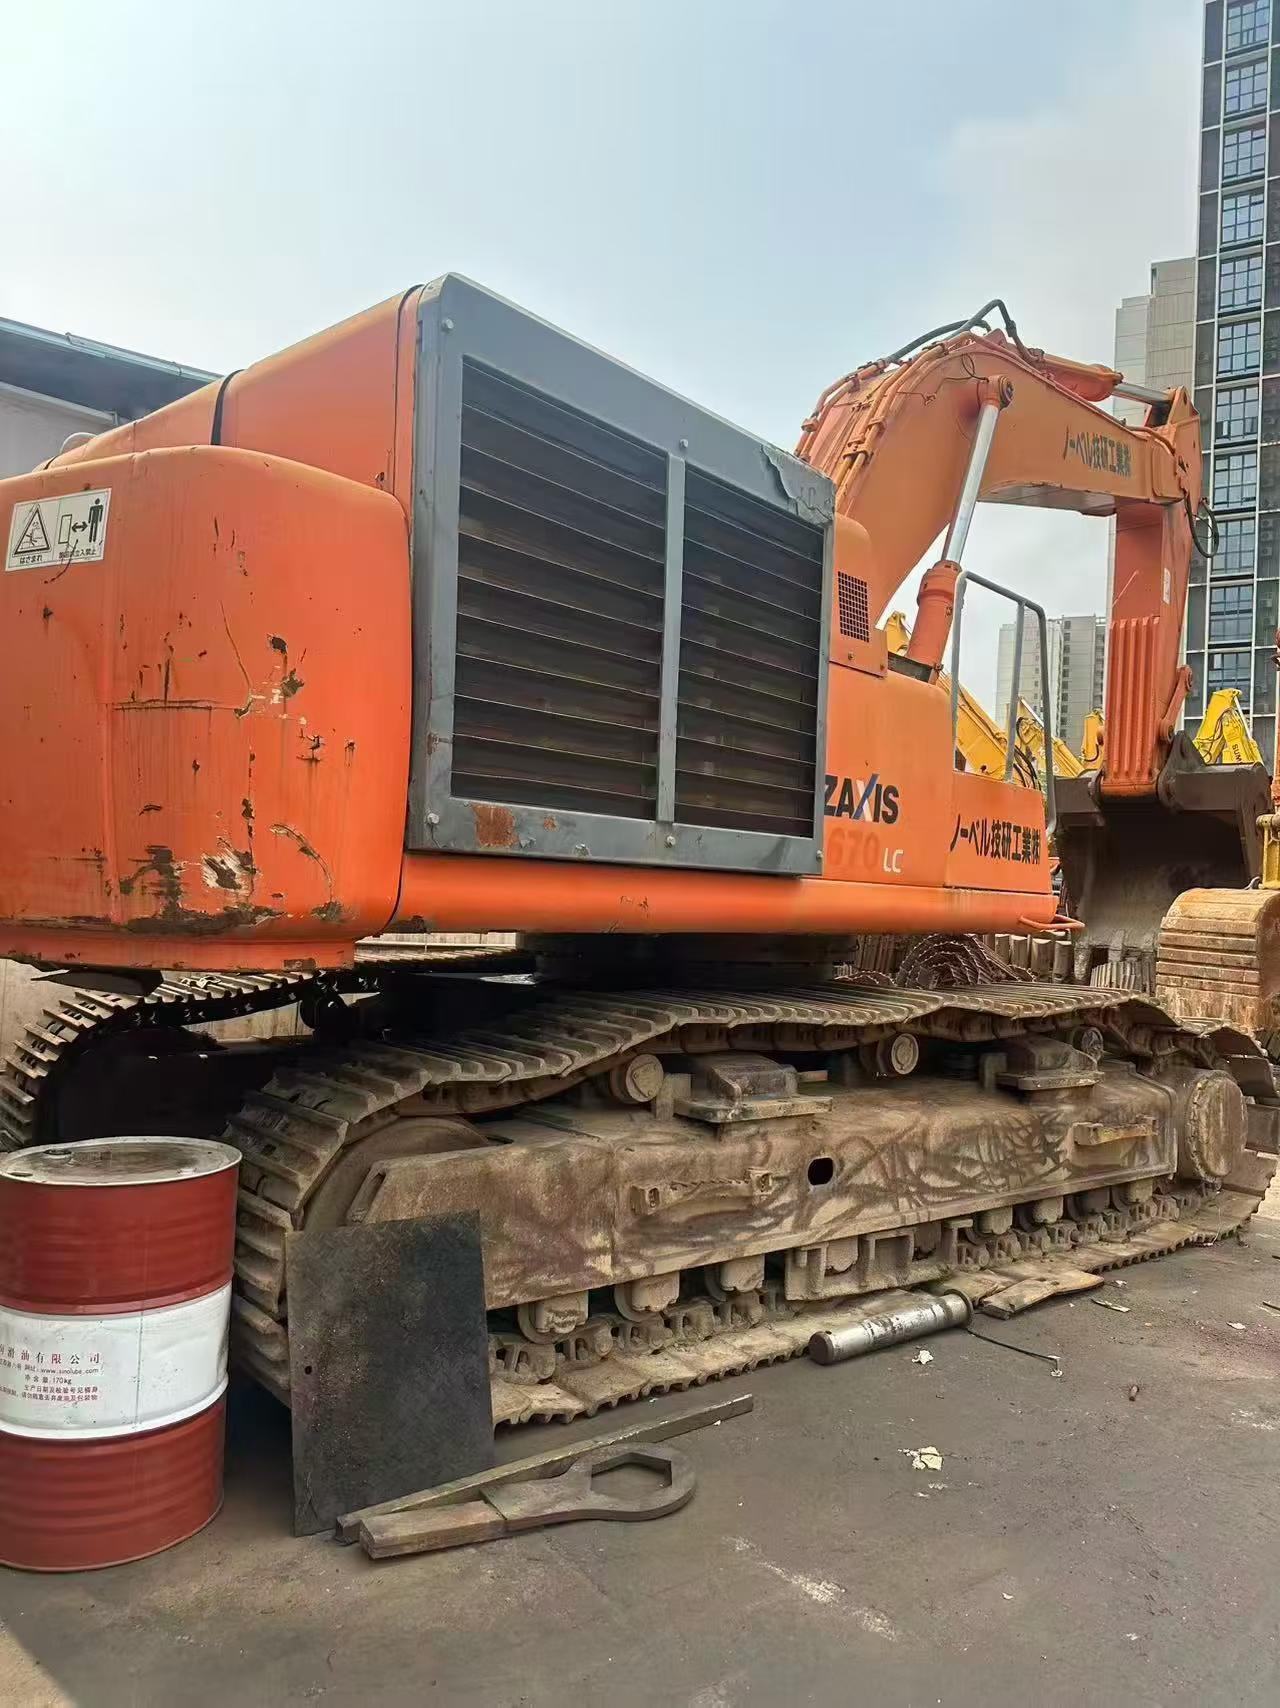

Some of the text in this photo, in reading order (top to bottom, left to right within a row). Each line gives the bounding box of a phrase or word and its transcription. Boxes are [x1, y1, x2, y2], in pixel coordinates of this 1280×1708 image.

[824, 773, 900, 825] ZAXIS
[827, 827, 904, 873] 670 LC
